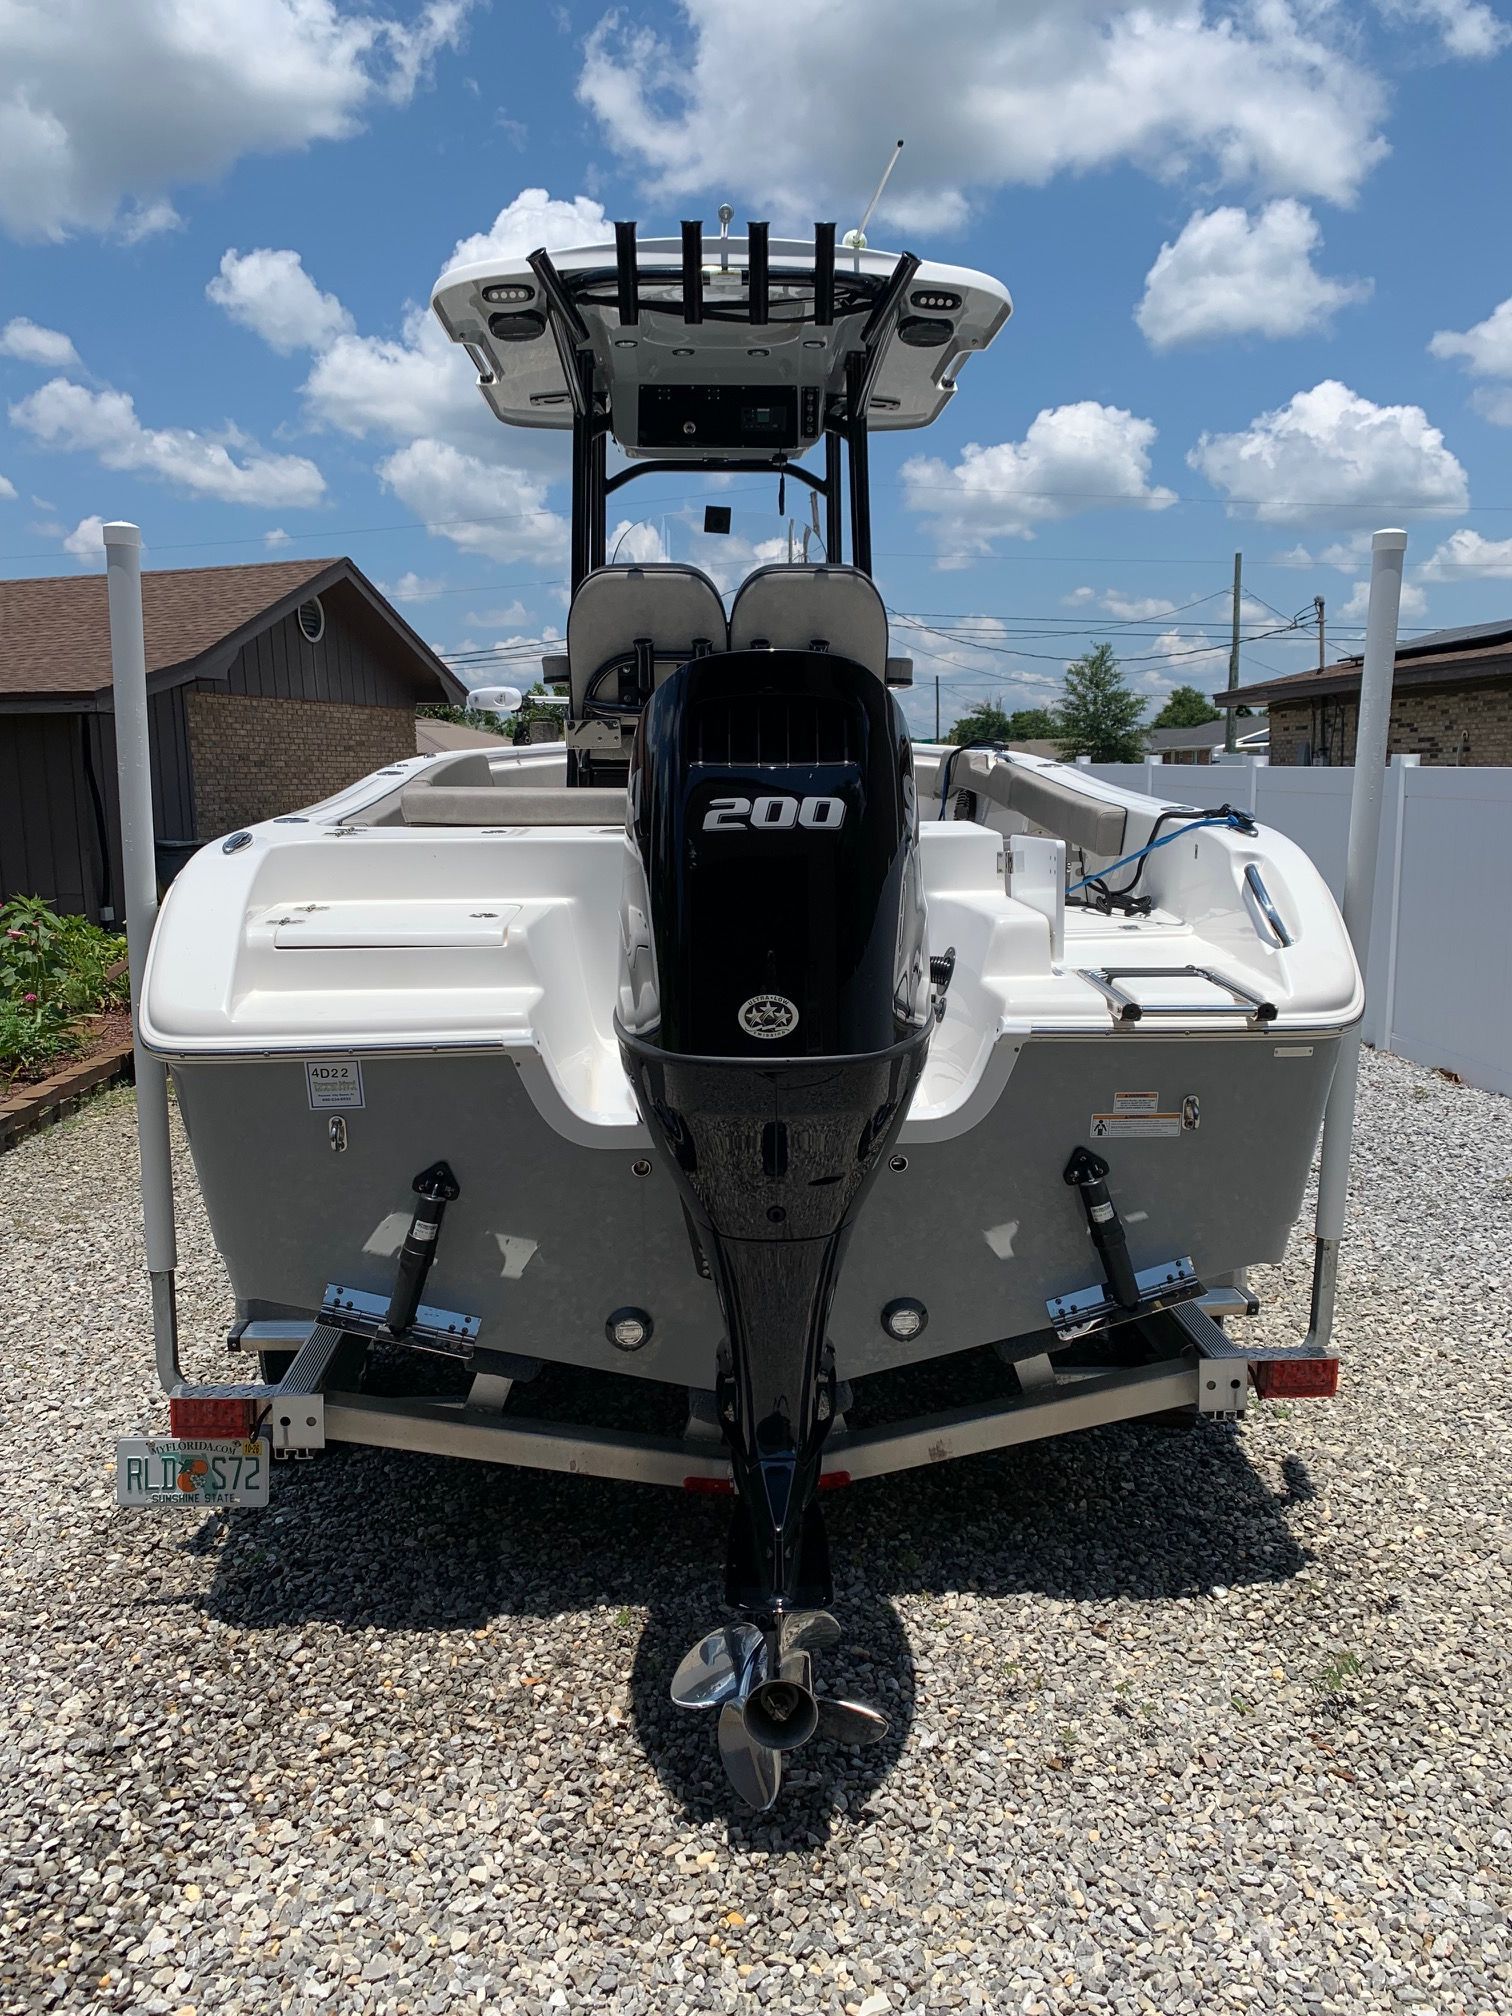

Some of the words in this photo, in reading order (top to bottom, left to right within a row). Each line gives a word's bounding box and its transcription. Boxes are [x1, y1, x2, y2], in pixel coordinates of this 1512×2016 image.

[702, 796, 848, 832] 200
[311, 1068, 349, 1079] 4D22
[151, 1441, 237, 1455] MYFLORIDA.COM
[127, 1456, 176, 1491] RLD
[211, 1457, 260, 1490] S72
[151, 1493, 200, 1504] SUNSHINE
[204, 1493, 235, 1503] STATE
